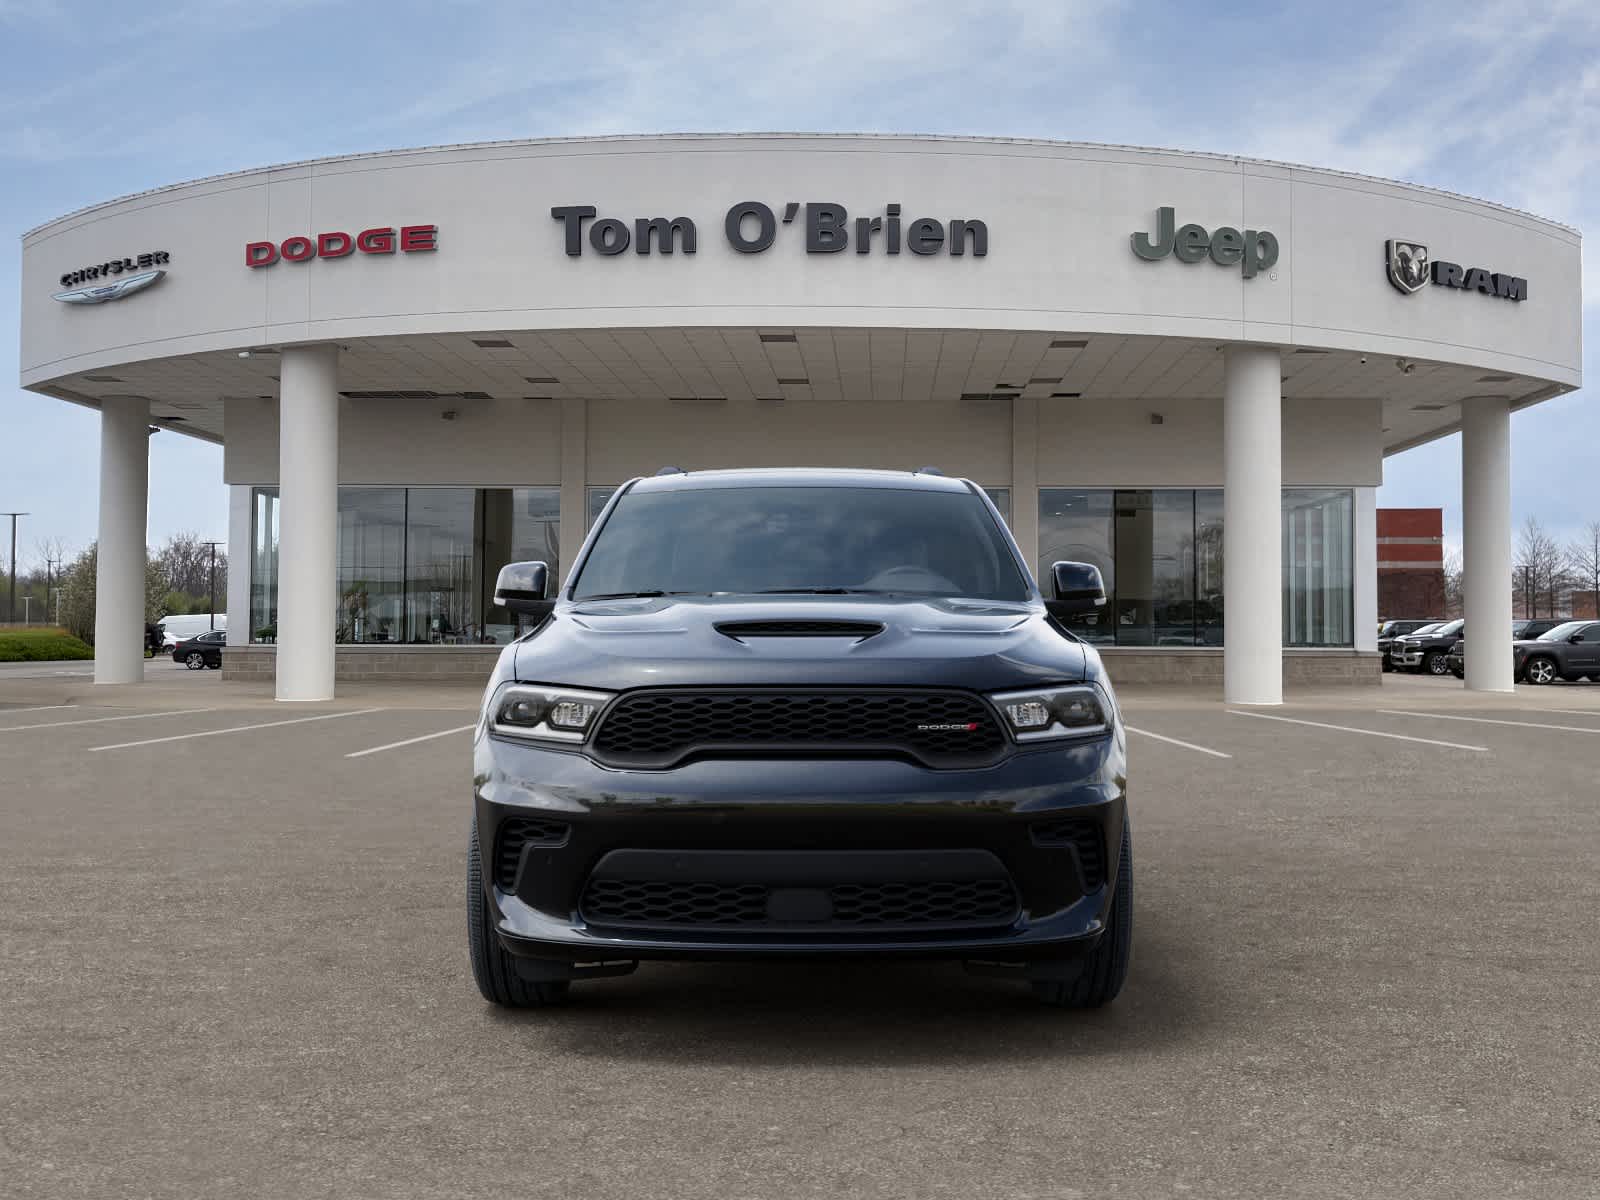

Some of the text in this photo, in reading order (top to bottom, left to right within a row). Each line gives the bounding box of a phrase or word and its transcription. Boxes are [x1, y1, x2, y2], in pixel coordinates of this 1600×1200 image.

[245, 225, 437, 269] DODGE
[551, 201, 989, 257] Tom O'Brien
[1130, 206, 1280, 279] Jeep
[60, 251, 170, 286] CHRYSLER
[1431, 260, 1528, 301] RAM
